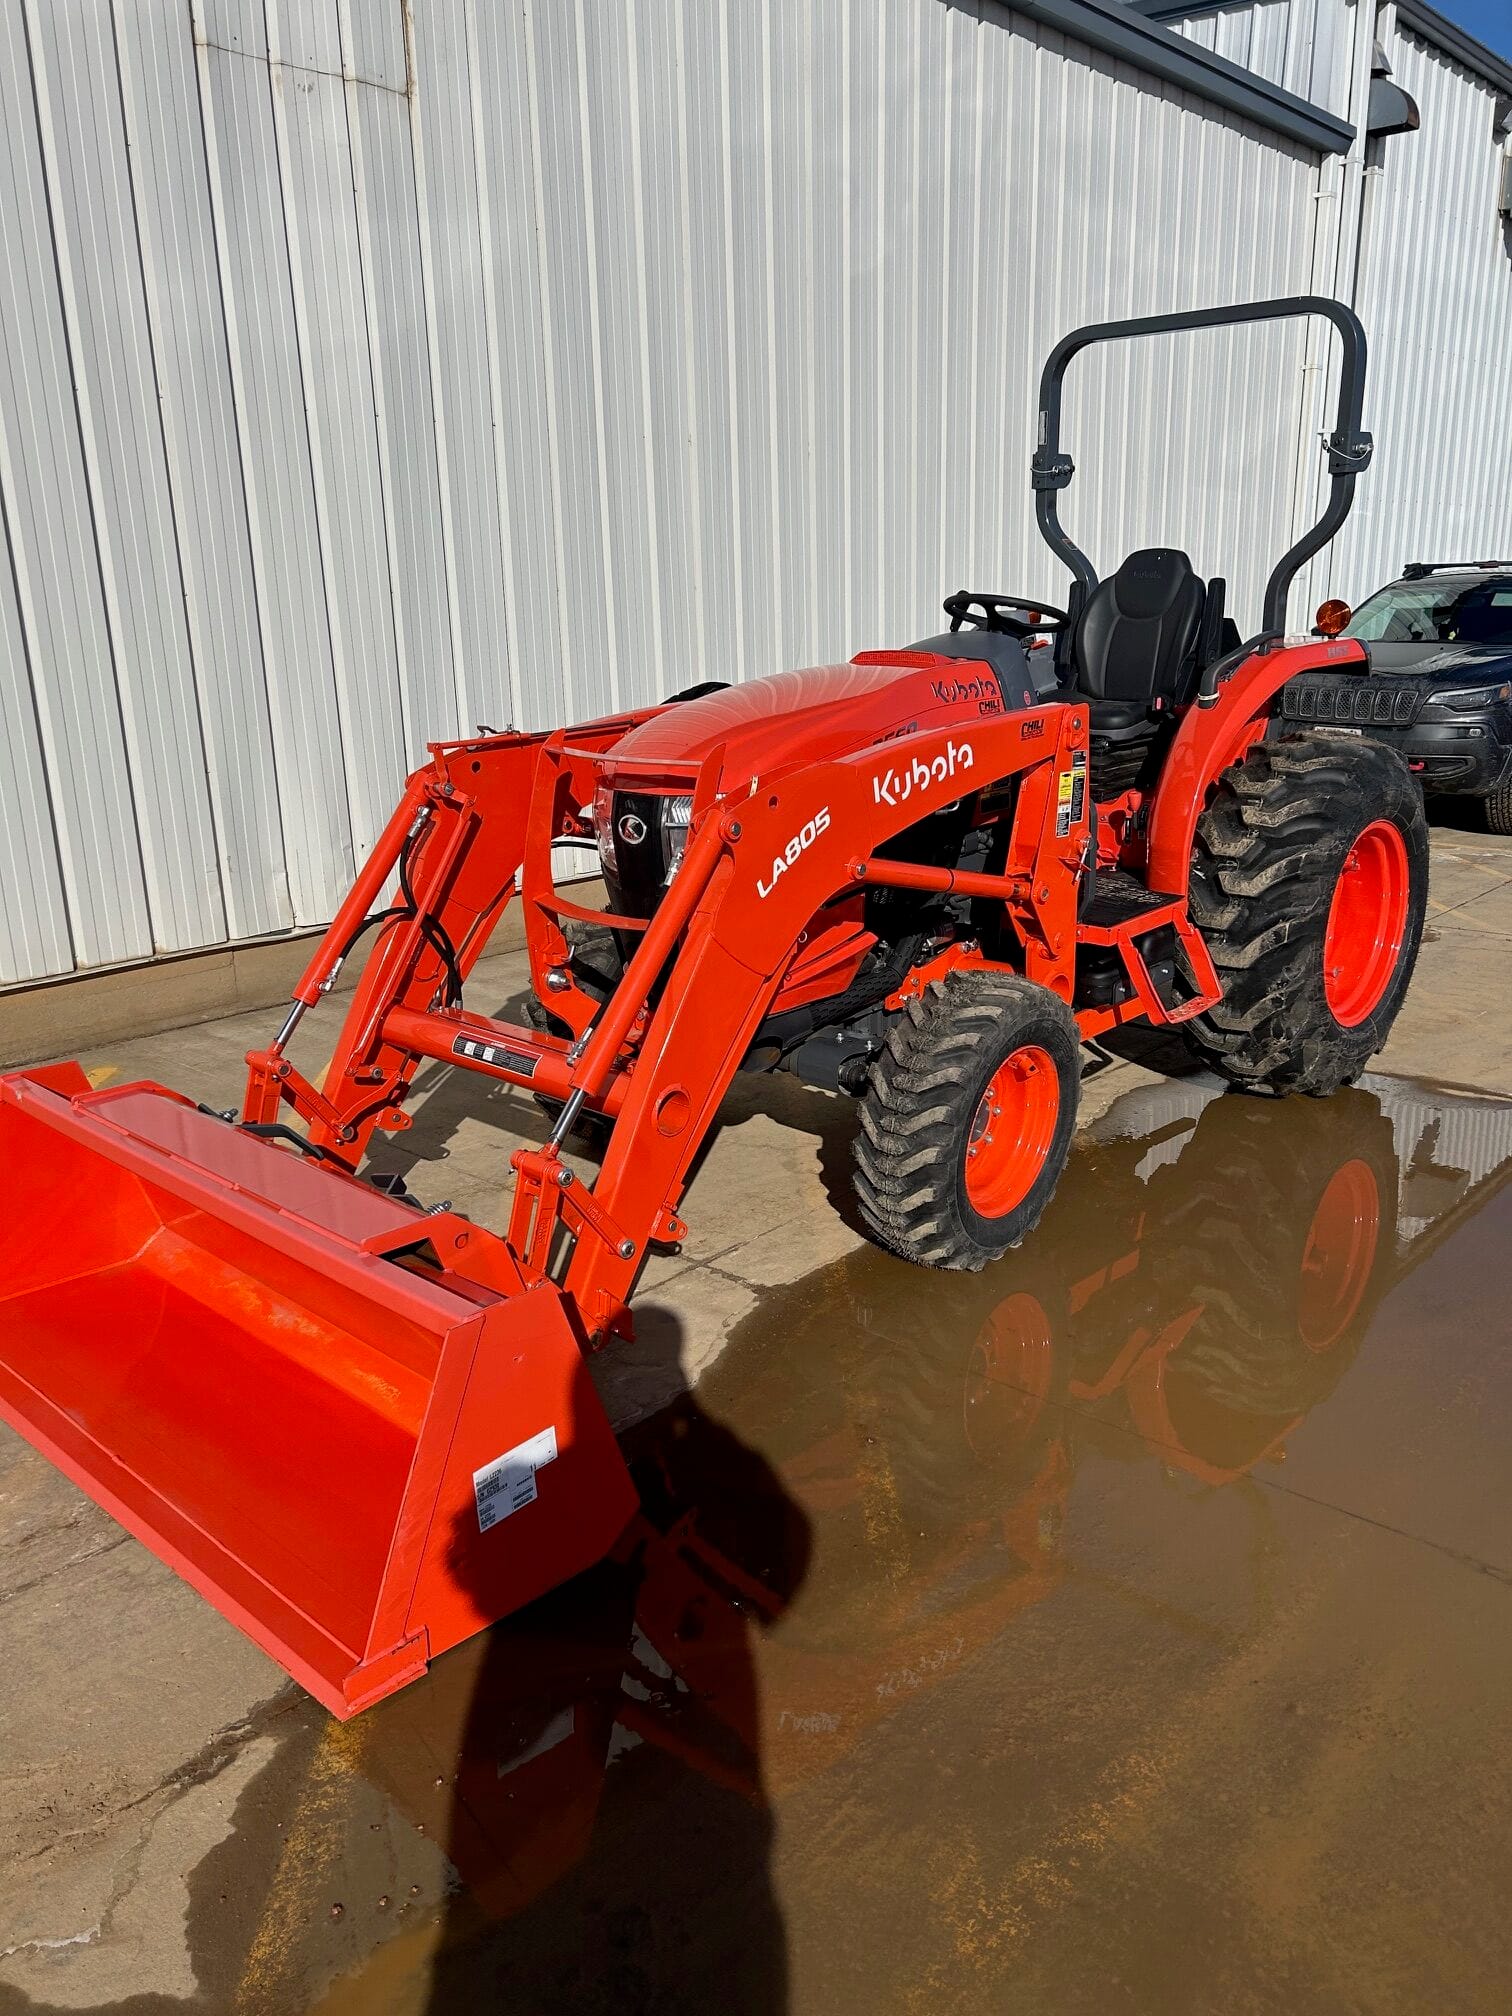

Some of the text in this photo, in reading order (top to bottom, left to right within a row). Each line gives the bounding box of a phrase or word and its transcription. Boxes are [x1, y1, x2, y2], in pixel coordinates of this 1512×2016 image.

[931, 676, 997, 703] Kubota
[1021, 719, 1045, 737] CHILI
[873, 740, 974, 806] Kubota
[757, 806, 831, 898] LA805
